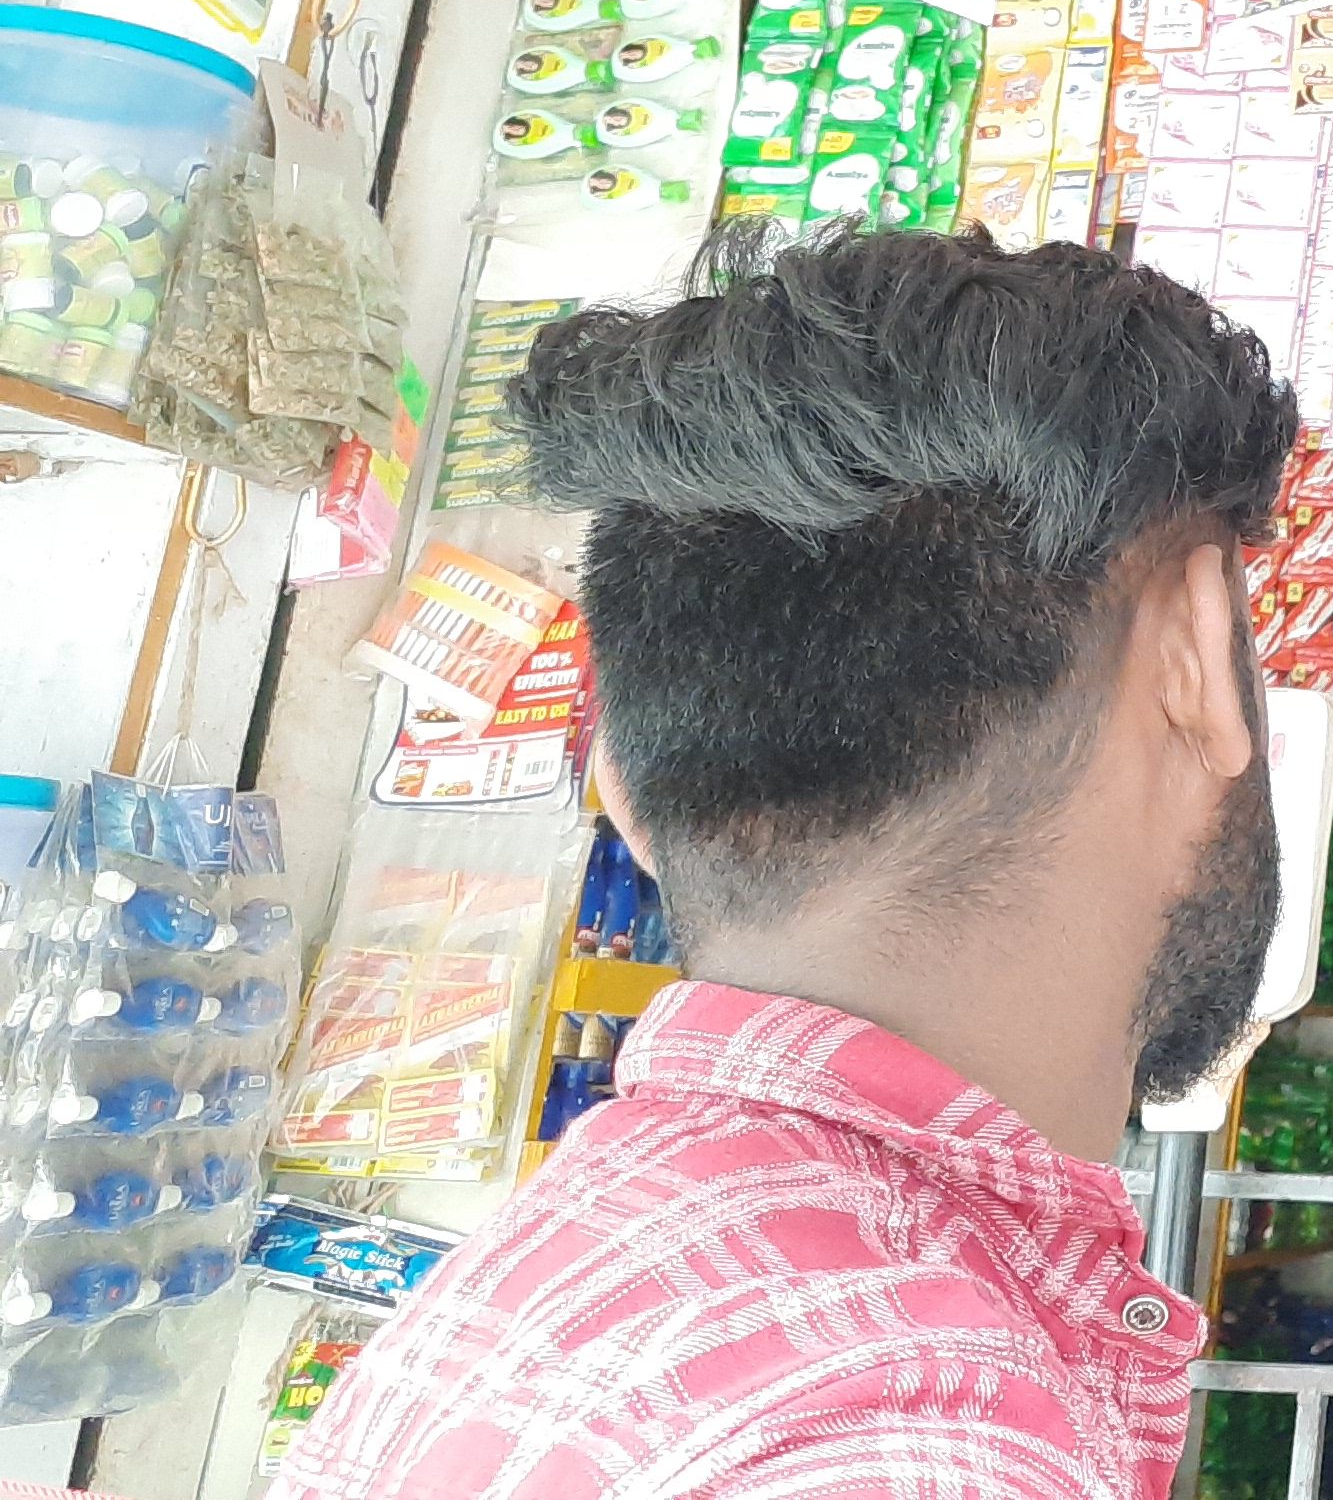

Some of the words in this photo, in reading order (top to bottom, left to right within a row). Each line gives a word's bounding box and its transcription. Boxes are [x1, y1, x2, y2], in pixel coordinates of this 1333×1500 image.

[495, 707, 529, 726] EASY
[316, 1239, 362, 1261] Magic
[363, 1248, 405, 1271] Stick
